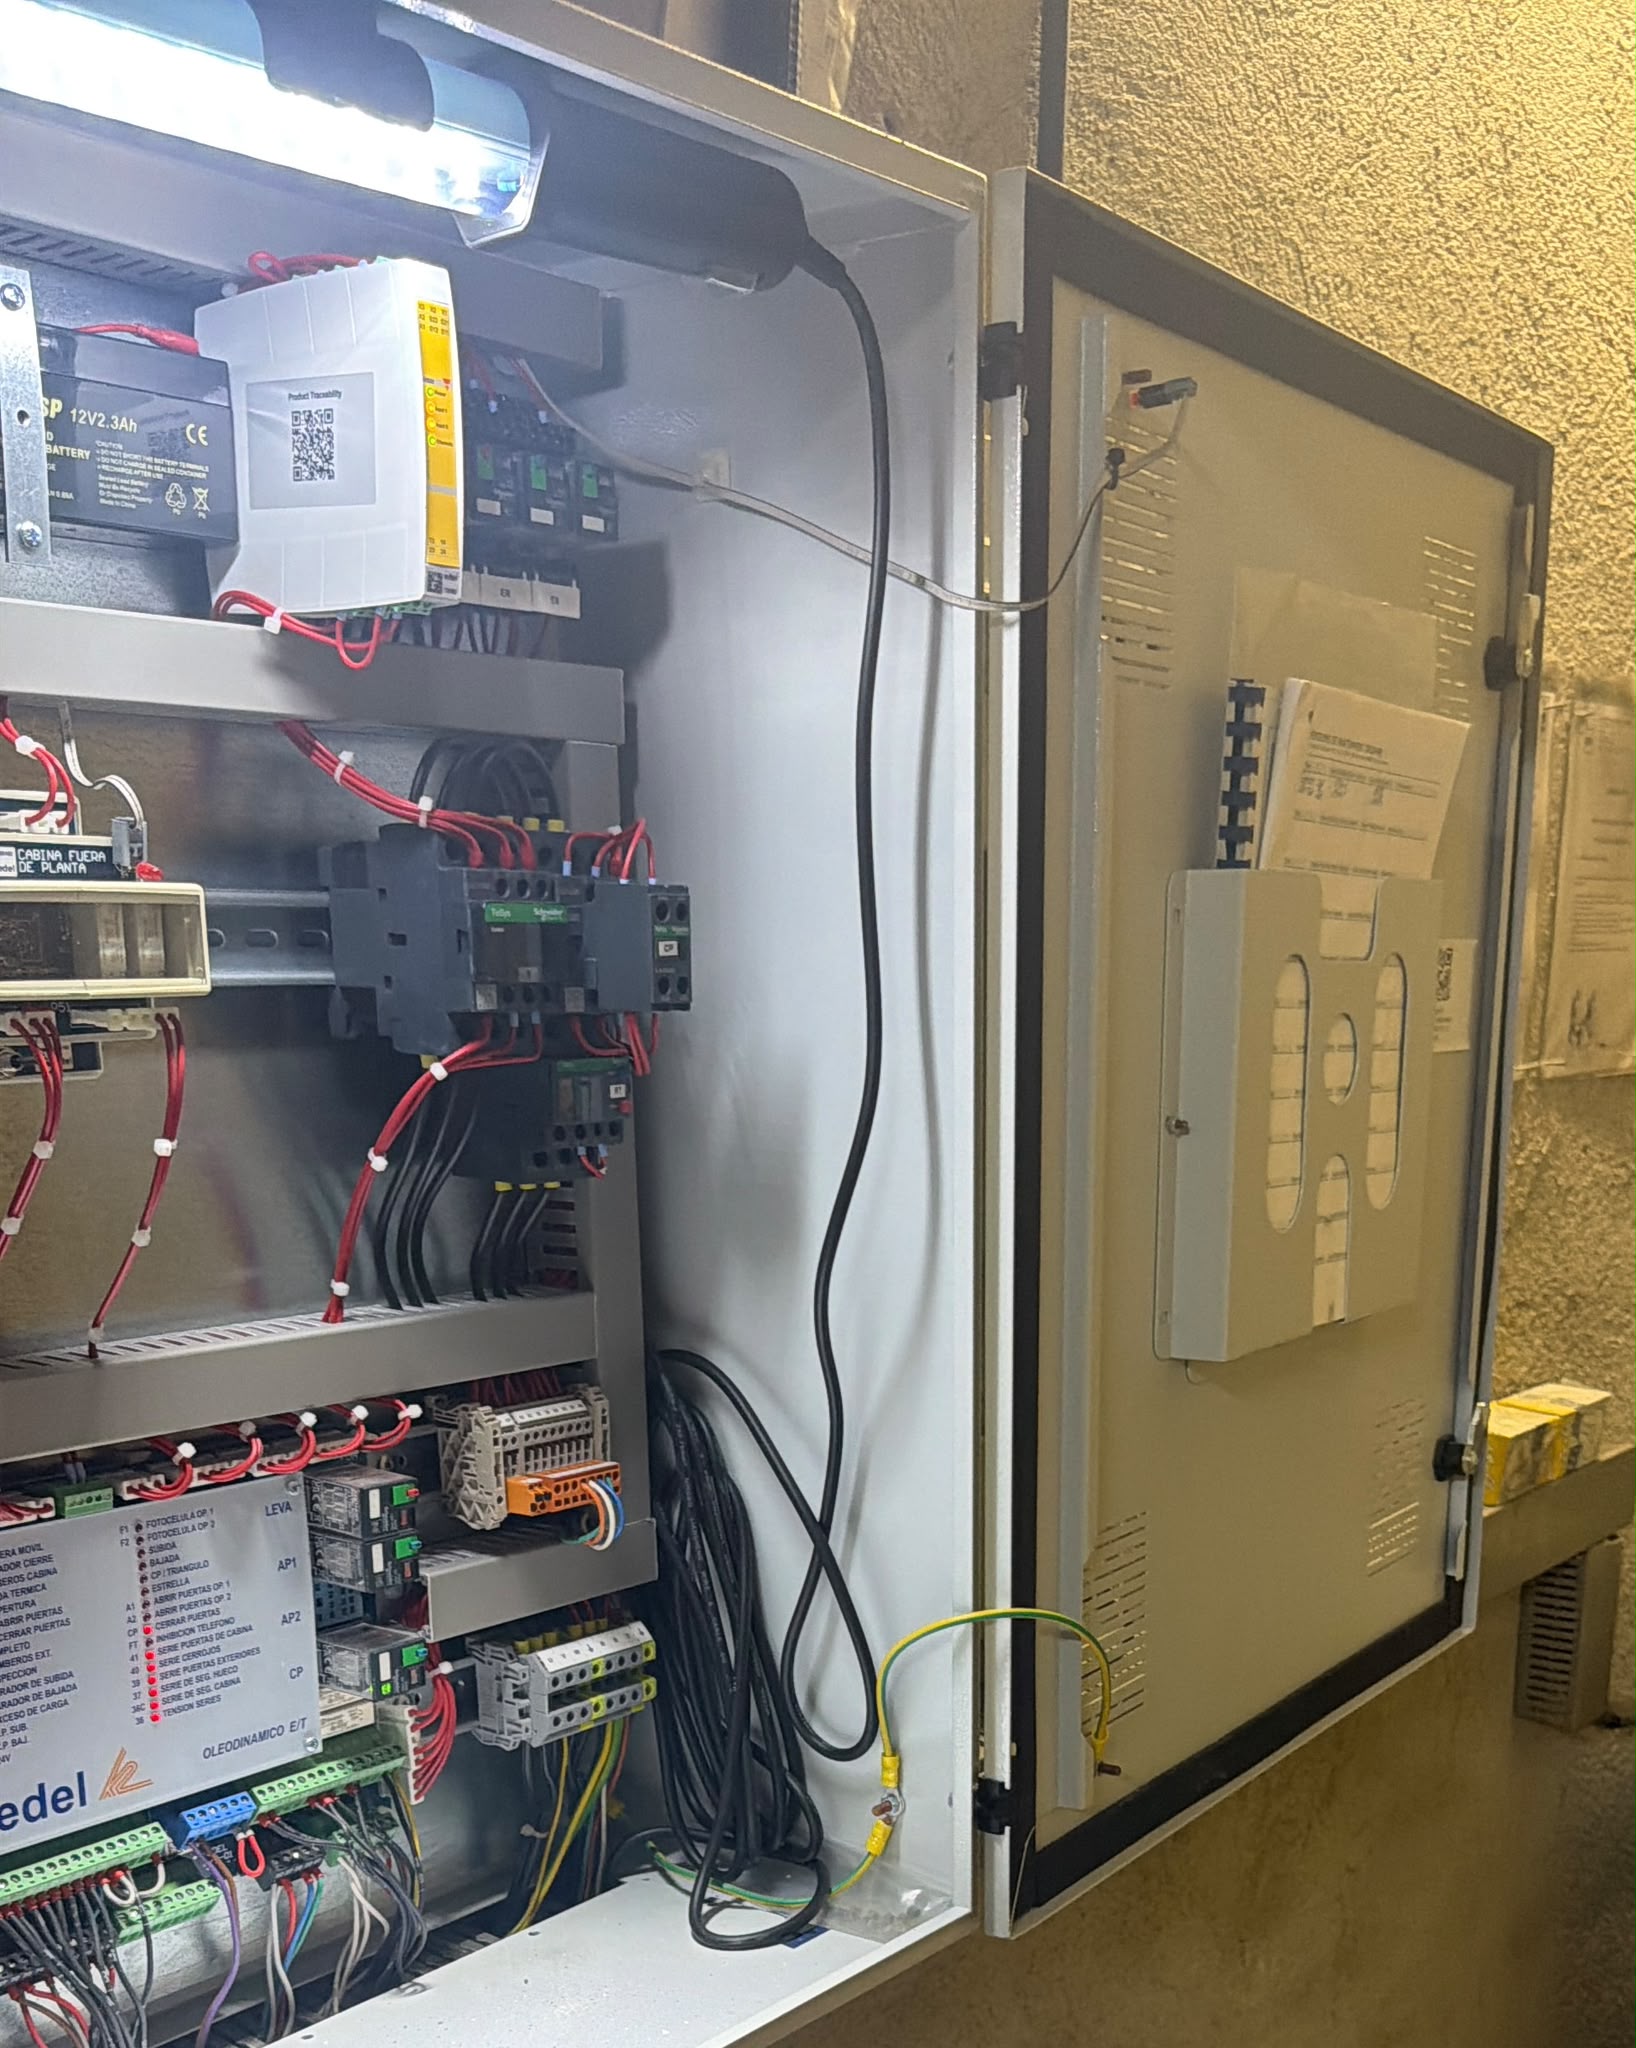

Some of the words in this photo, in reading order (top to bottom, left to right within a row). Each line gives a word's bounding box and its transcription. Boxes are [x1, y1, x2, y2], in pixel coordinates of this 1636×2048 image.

[287, 392, 309, 401] Product
[310, 389, 342, 399] Traceability
[70, 408, 137, 433] 12V2.3Ah
[186, 423, 208, 446] CE
[47, 445, 91, 460] BATTERY
[17, 849, 62, 861] CABINA
[68, 850, 106, 862] FUERA
[18, 861, 34, 873] DE
[41, 862, 87, 874] PLANTA
[264, 1501, 293, 1517] LEVA
[146, 1512, 196, 1528] FOTOCELULA
[119, 1525, 129, 1534] F1
[147, 1525, 197, 1541] FOTOCELULA
[210, 1520, 215, 1528] 2
[18, 1543, 44, 1554] MOVIL
[120, 1538, 129, 1547] F2
[148, 1541, 177, 1554] SUBIDA
[23, 1554, 54, 1568] CIERRE
[149, 1554, 180, 1567] BAJADA
[277, 1557, 297, 1572] AP1
[0, 1574, 25, 1587] EROS
[27, 1567, 58, 1580] CABINA
[150, 1570, 161, 1579] CP
[167, 1560, 209, 1576] TRIANGULO
[10, 1583, 47, 1598] TERMICA
[151, 1577, 190, 1593] ESTRELLA
[154, 1593, 177, 1605] ABRIR
[178, 1585, 211, 1599] PUERTAS
[25, 1606, 63, 1621] PUERTAS
[126, 1603, 135, 1611] A1
[155, 1606, 178, 1618] ABRIR
[179, 1598, 213, 1612] PUERTAS
[33, 1618, 71, 1633] PUERTAS
[127, 1615, 136, 1624] A2
[155, 1616, 186, 1630] CERRAR
[187, 1607, 221, 1621] PUERTAS
[280, 1611, 301, 1626] AP2
[127, 1628, 138, 1637] CP
[156, 1627, 195, 1643] INHIBICION
[197, 1616, 236, 1632] TELEFONO
[157, 1643, 179, 1656] SERIE
[180, 1634, 214, 1649] PUERTAS
[215, 1631, 225, 1640] DE
[226, 1624, 253, 1637] CABINA
[158, 1655, 180, 1668] SERIE
[182, 1645, 221, 1662] CERROJOS
[159, 1668, 181, 1680] SERIE
[182, 1659, 215, 1674] PUERTAS
[217, 1646, 261, 1665] EXTERIORES
[0, 1666, 37, 1683] PECCION
[30, 1679, 42, 1688] DE
[44, 1671, 75, 1684] SUBIDA
[160, 1680, 182, 1693] SERIE
[183, 1677, 194, 1686] DE
[213, 1665, 238, 1678] HUECO
[289, 1666, 304, 1680] CP
[0, 1695, 31, 1709] RADOR
[32, 1692, 43, 1701] DE
[45, 1683, 78, 1698] BAJADA
[161, 1693, 183, 1705] SERIE
[184, 1689, 194, 1699] DE
[214, 1676, 241, 1691] CABINA
[27, 1706, 39, 1716] DE
[40, 1699, 70, 1713] CARGA
[163, 1702, 194, 1717] TENSION
[195, 1694, 222, 1708] SERIES
[202, 1724, 285, 1759] OLEODINAMICO
[289, 1717, 307, 1733] E/T
[0, 1771, 87, 1831] edel
